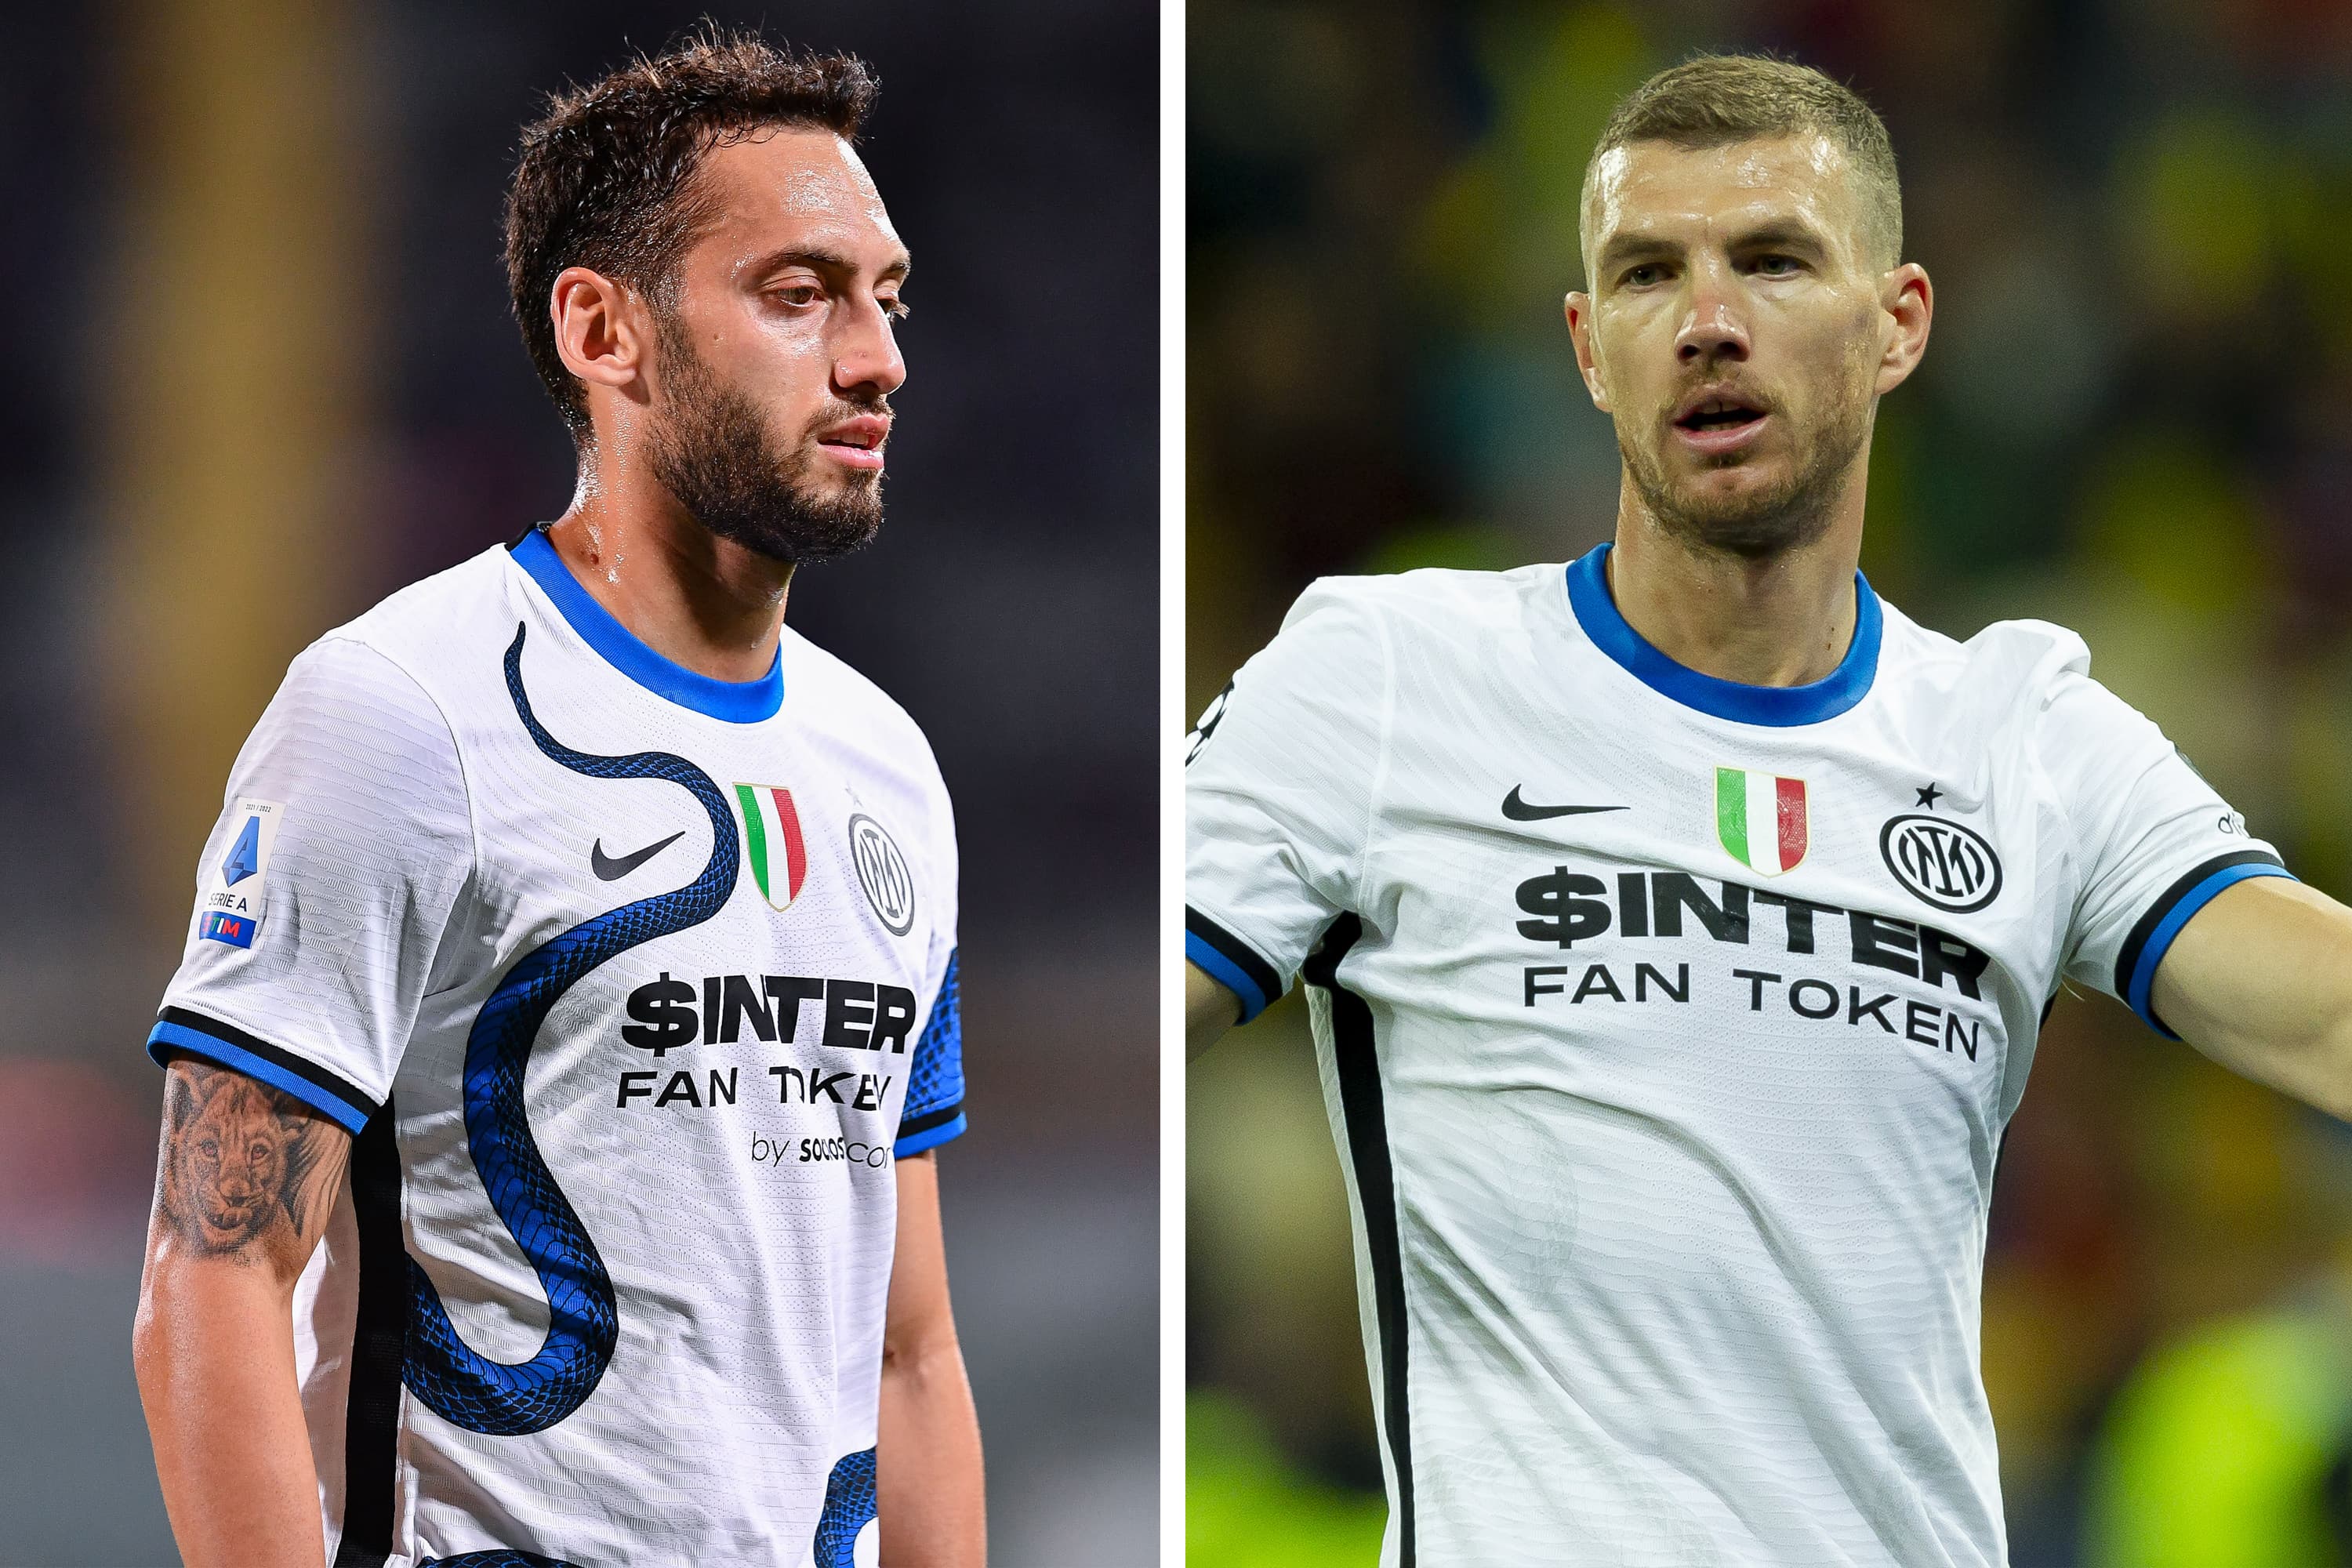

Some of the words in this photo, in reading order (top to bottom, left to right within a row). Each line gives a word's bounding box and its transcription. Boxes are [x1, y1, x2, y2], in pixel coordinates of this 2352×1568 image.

[209, 893, 235, 908] SERIE
[236, 897, 247, 912] A
[211, 916, 240, 938] TIM
[1515, 865, 1992, 1001] $INTER
[621, 972, 916, 1058] $INTER
[1523, 963, 1690, 1007] FAN
[1732, 968, 1980, 1063] TOKEN
[616, 1067, 738, 1109] FAN
[751, 1131, 790, 1168] by
[799, 1137, 891, 1168] socosco
